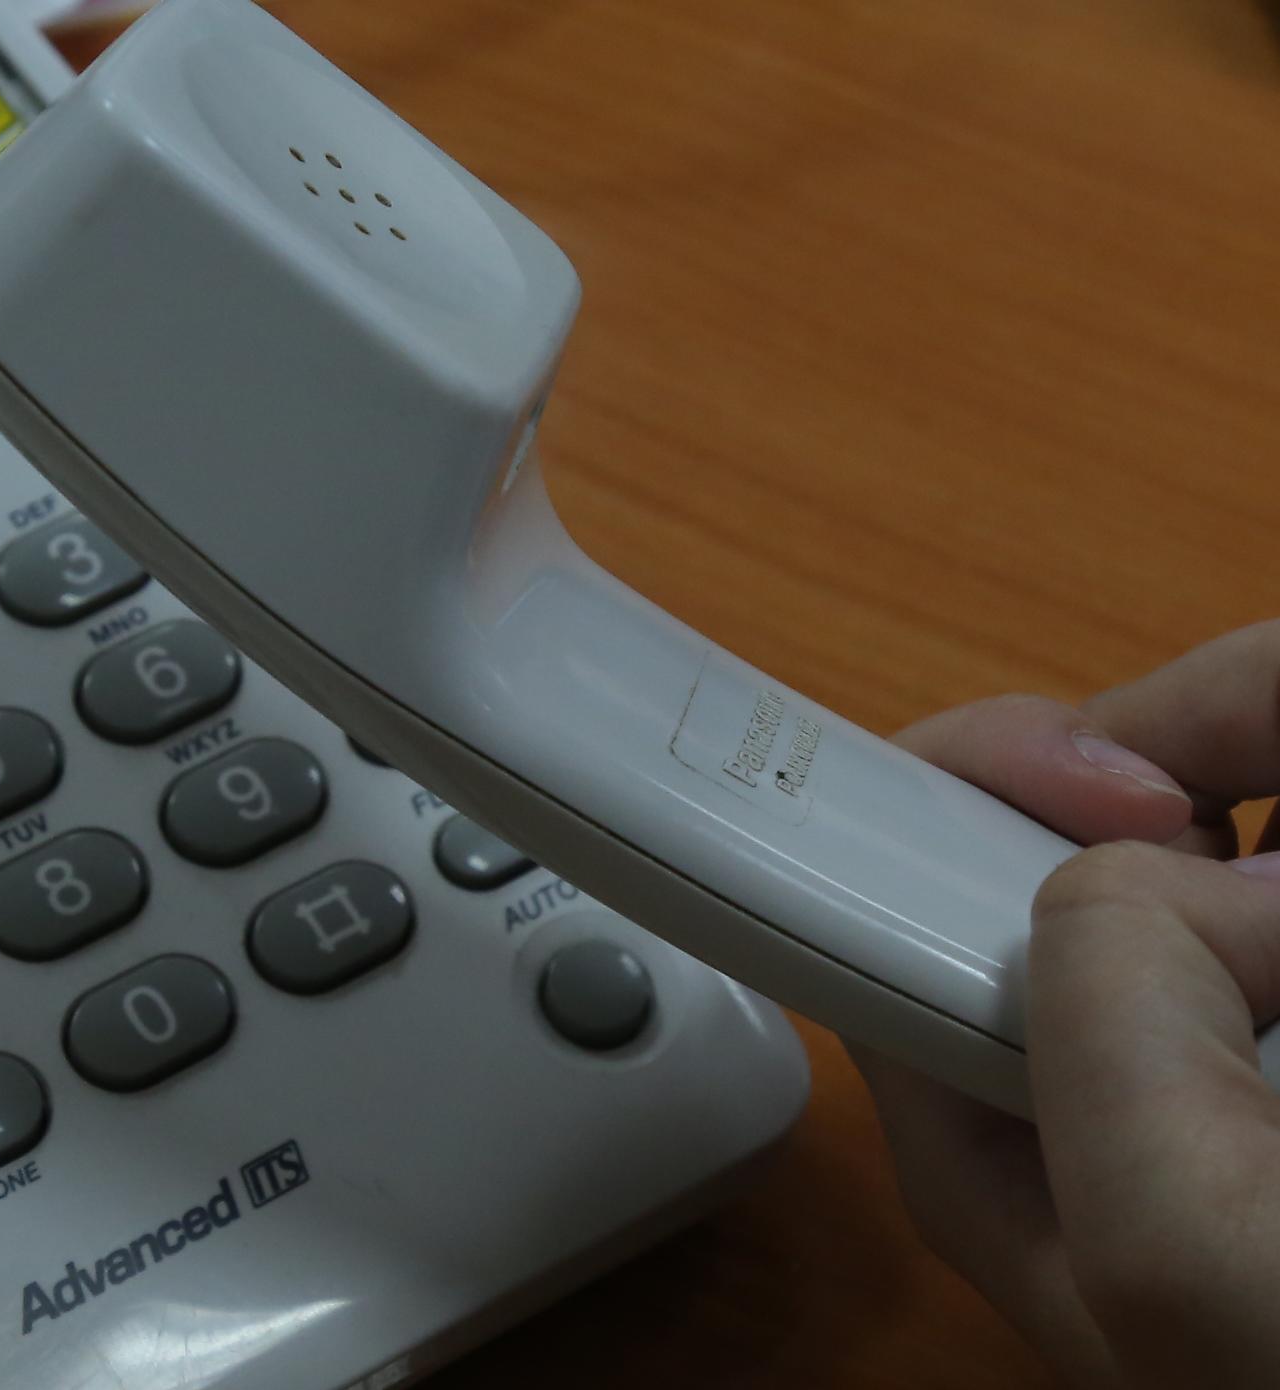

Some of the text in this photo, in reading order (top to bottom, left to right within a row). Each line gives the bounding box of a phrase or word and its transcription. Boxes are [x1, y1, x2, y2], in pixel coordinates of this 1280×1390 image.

[9, 495, 57, 529] DEF
[47, 532, 102, 585] 3
[88, 607, 149, 646] MNO
[133, 646, 187, 698] 6
[164, 718, 241, 767] WXYZ
[218, 766, 274, 820] 9
[35, 858, 91, 915] 8
[504, 879, 579, 933] AUTO
[122, 984, 177, 1044] 0
[21, 1142, 308, 1335] Advanced ITS
